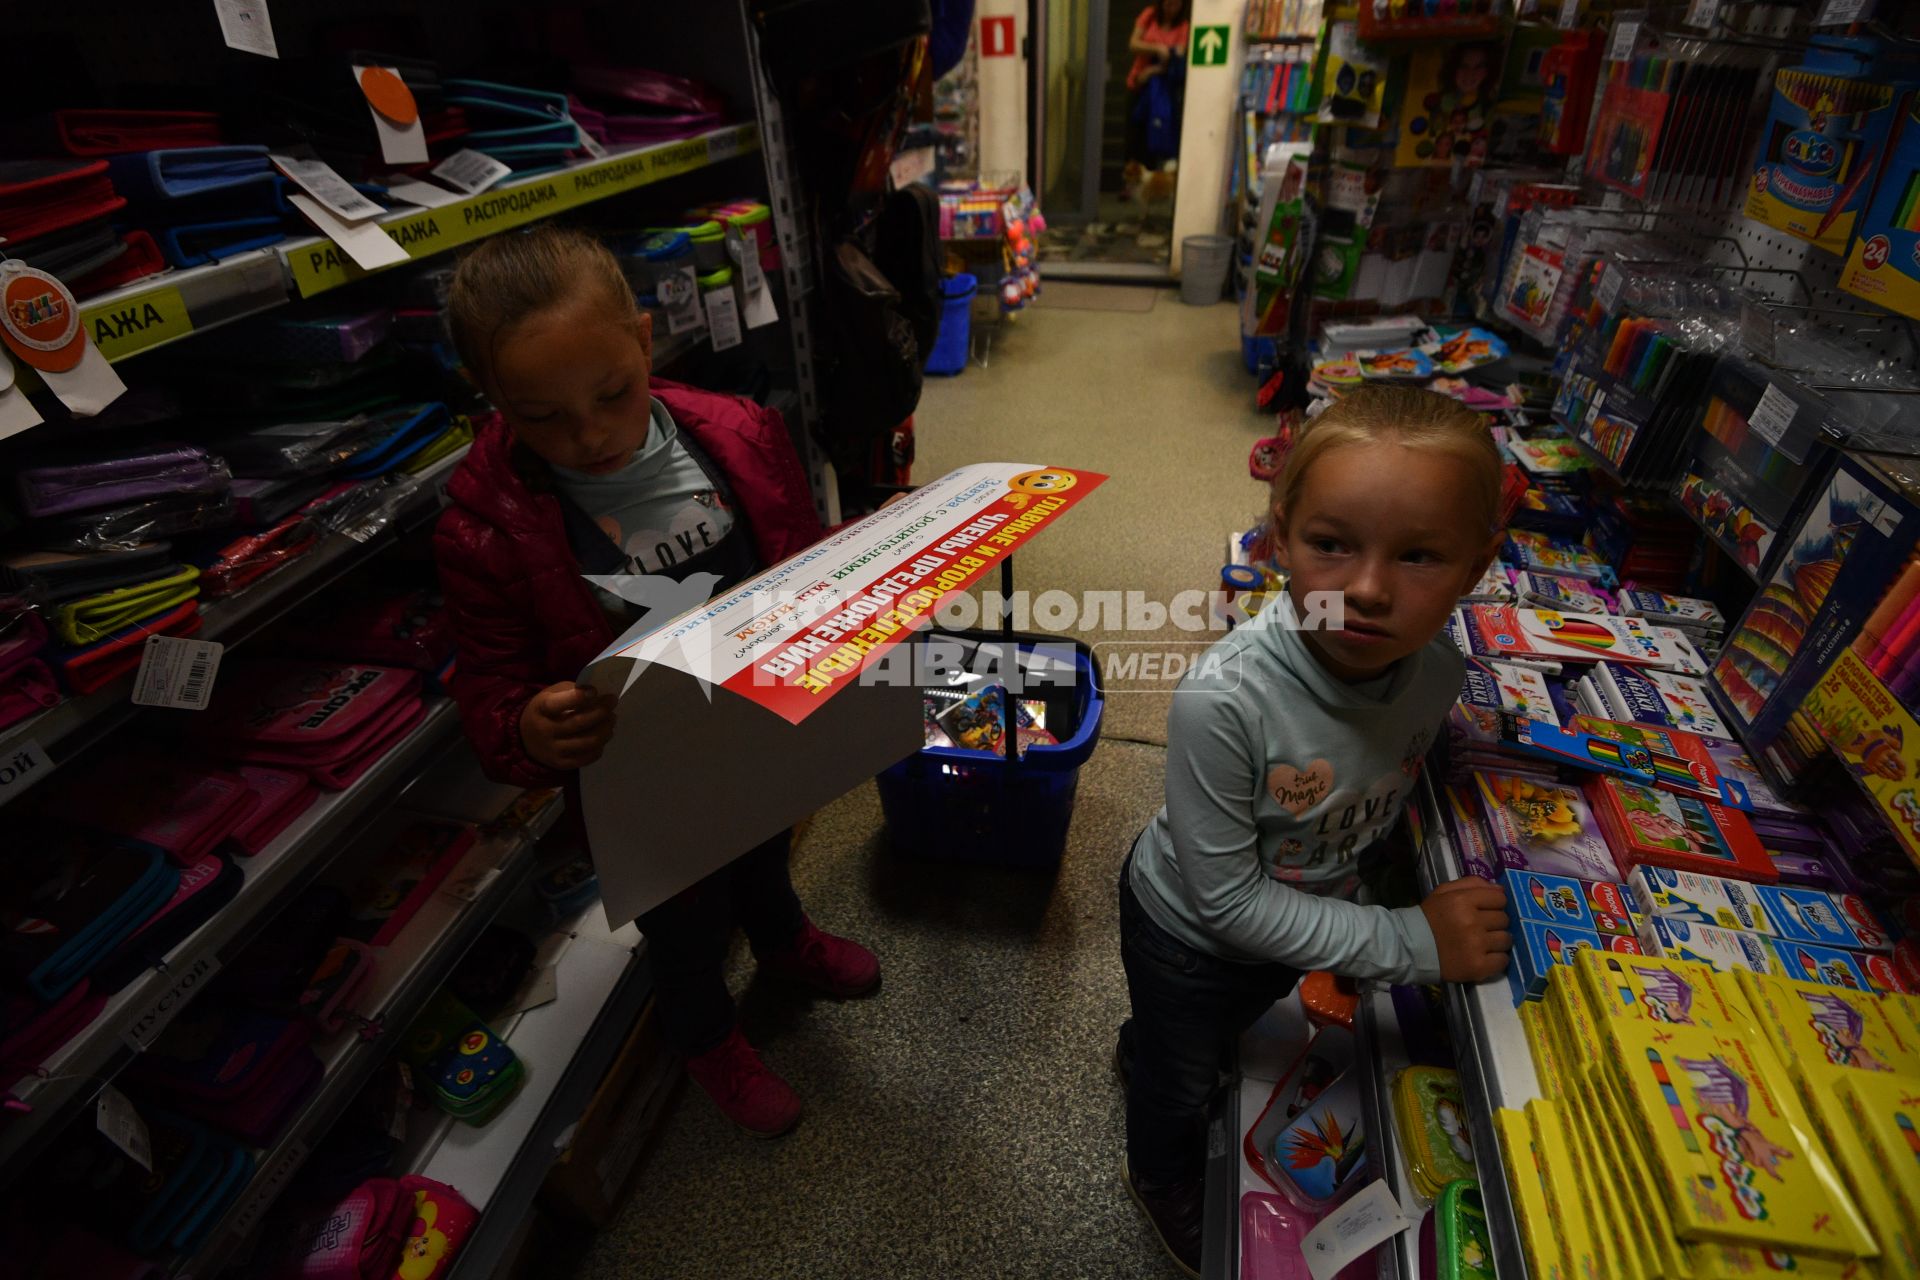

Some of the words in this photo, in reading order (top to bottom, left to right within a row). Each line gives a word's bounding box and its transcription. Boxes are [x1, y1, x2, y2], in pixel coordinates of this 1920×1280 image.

[464, 183, 558, 225] РАСПРОДАЖА
[574, 161, 645, 191] РАСПРОДАЖА
[1864, 242, 1888, 264] 24
[946, 478, 1002, 508] Завтра
[933, 512, 1010, 557] ЧЛЕНЫ
[988, 495, 1069, 556] ГЛАВНЫЕ
[831, 514, 937, 581] родителями
[972, 544, 1002, 559] И
[797, 580, 833, 602] мы
[733, 604, 796, 642] идём
[760, 553, 947, 678] ПРЕДЛОЖЕНИЯ
[792, 555, 988, 695] ВТОРОСТЕПЕННЫЕ
[735, 622, 785, 659] делаем?
[1624, 618, 1662, 659] CARIOCA
[1466, 669, 1490, 707] МЕЛКИ
[1617, 683, 1643, 720] CRAYONS
[1623, 675, 1655, 712] МЕЛКИ
[1825, 674, 1842, 693] 36
[1835, 664, 1885, 721] СМЫВАЕМЫЕ
[1842, 656, 1894, 715] ФЛОМАСТЕРЫ
[0, 752, 38, 789] ОЙ
[1275, 780, 1327, 806] Magic
[1317, 790, 1398, 836] LOVE
[1601, 884, 1621, 920] Maped
[129, 958, 210, 1041] ПУСТОЙ
